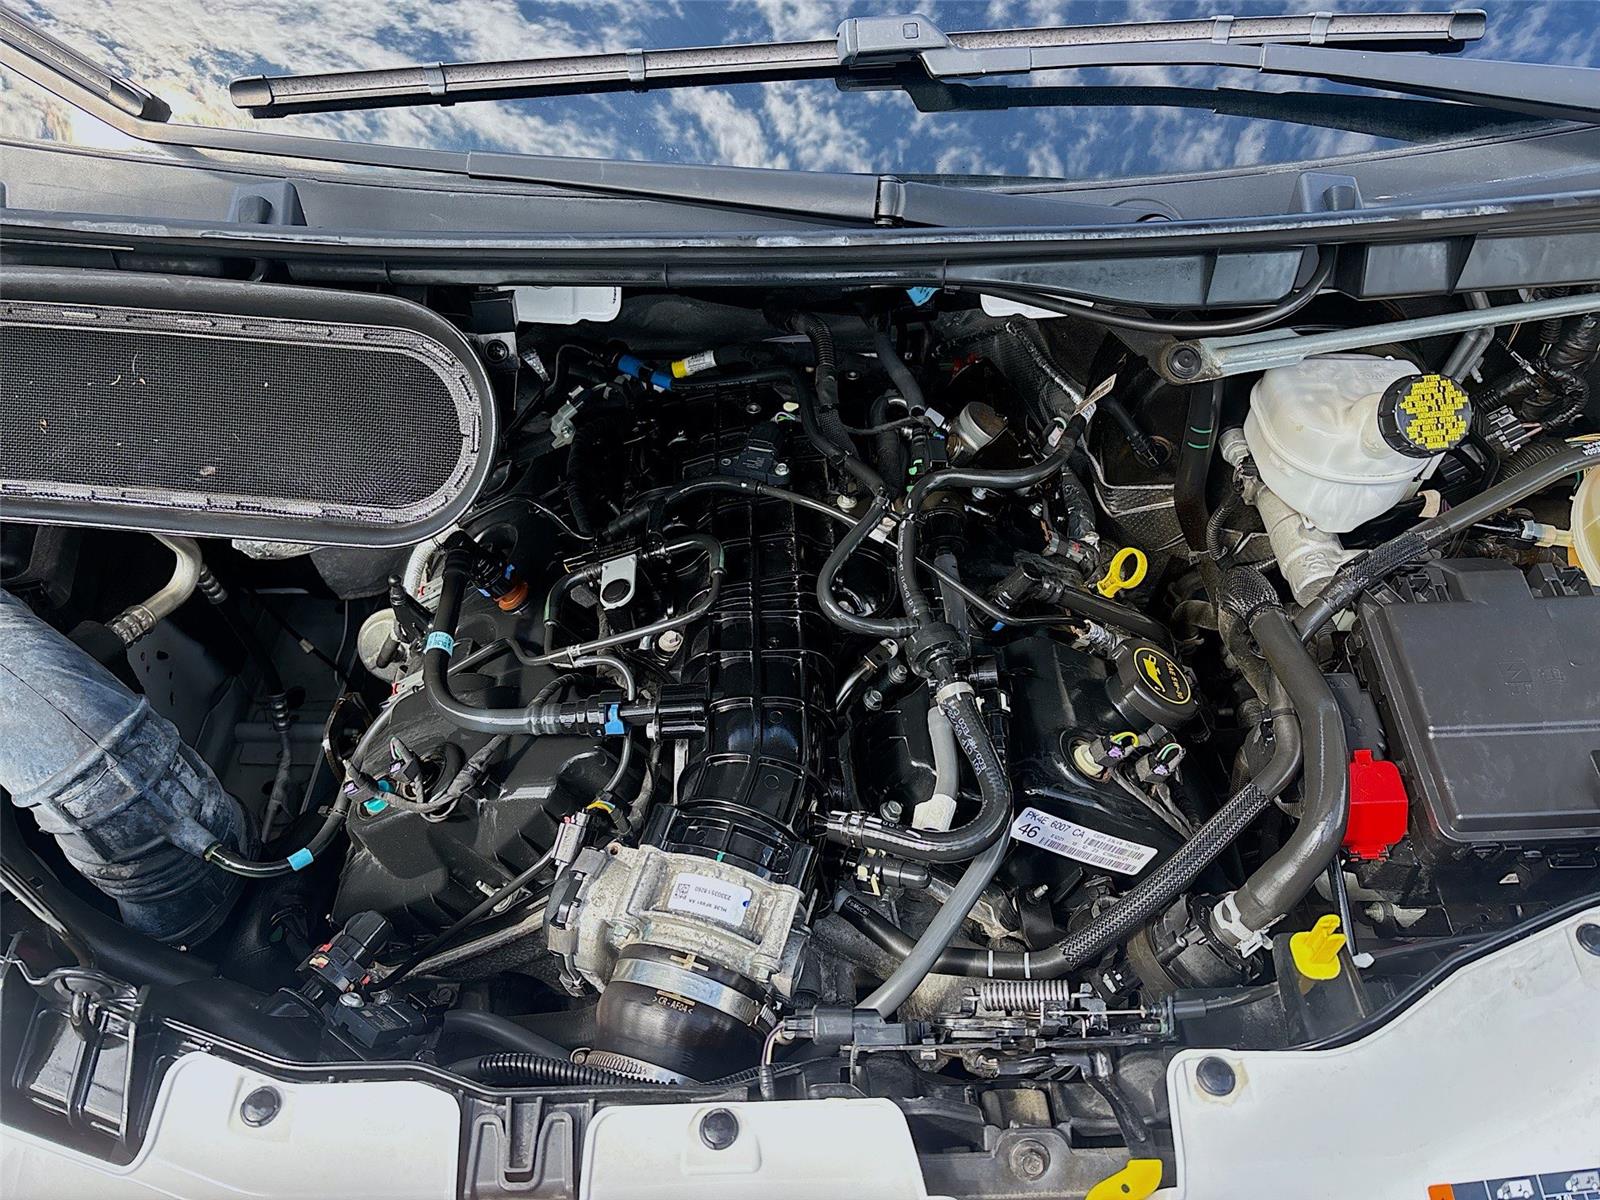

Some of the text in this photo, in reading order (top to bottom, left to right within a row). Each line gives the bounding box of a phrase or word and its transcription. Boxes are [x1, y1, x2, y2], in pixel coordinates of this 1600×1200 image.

[1018, 823, 1041, 839] 46
[1025, 810, 1050, 825] PK4E
[1050, 820, 1071, 833] 6007
[1071, 828, 1086, 839] CA
